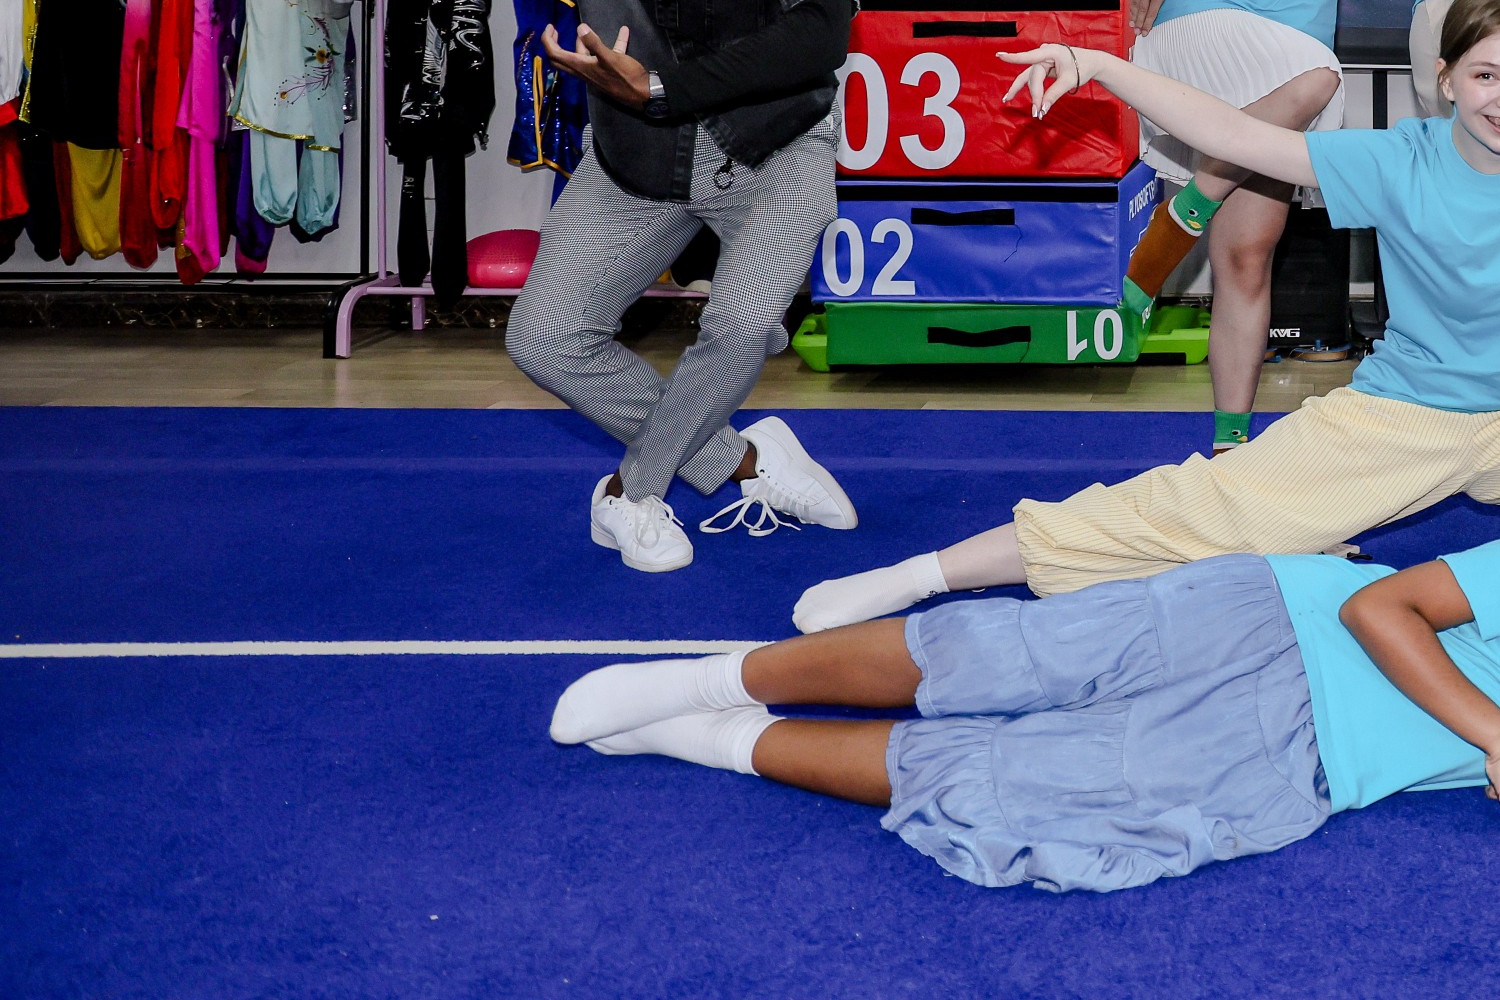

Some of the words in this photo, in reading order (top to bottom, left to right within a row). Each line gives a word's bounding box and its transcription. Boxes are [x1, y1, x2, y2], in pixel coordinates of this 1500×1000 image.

[835, 52, 966, 170] 03
[822, 218, 916, 297] 02
[1066, 309, 1124, 361] 01
